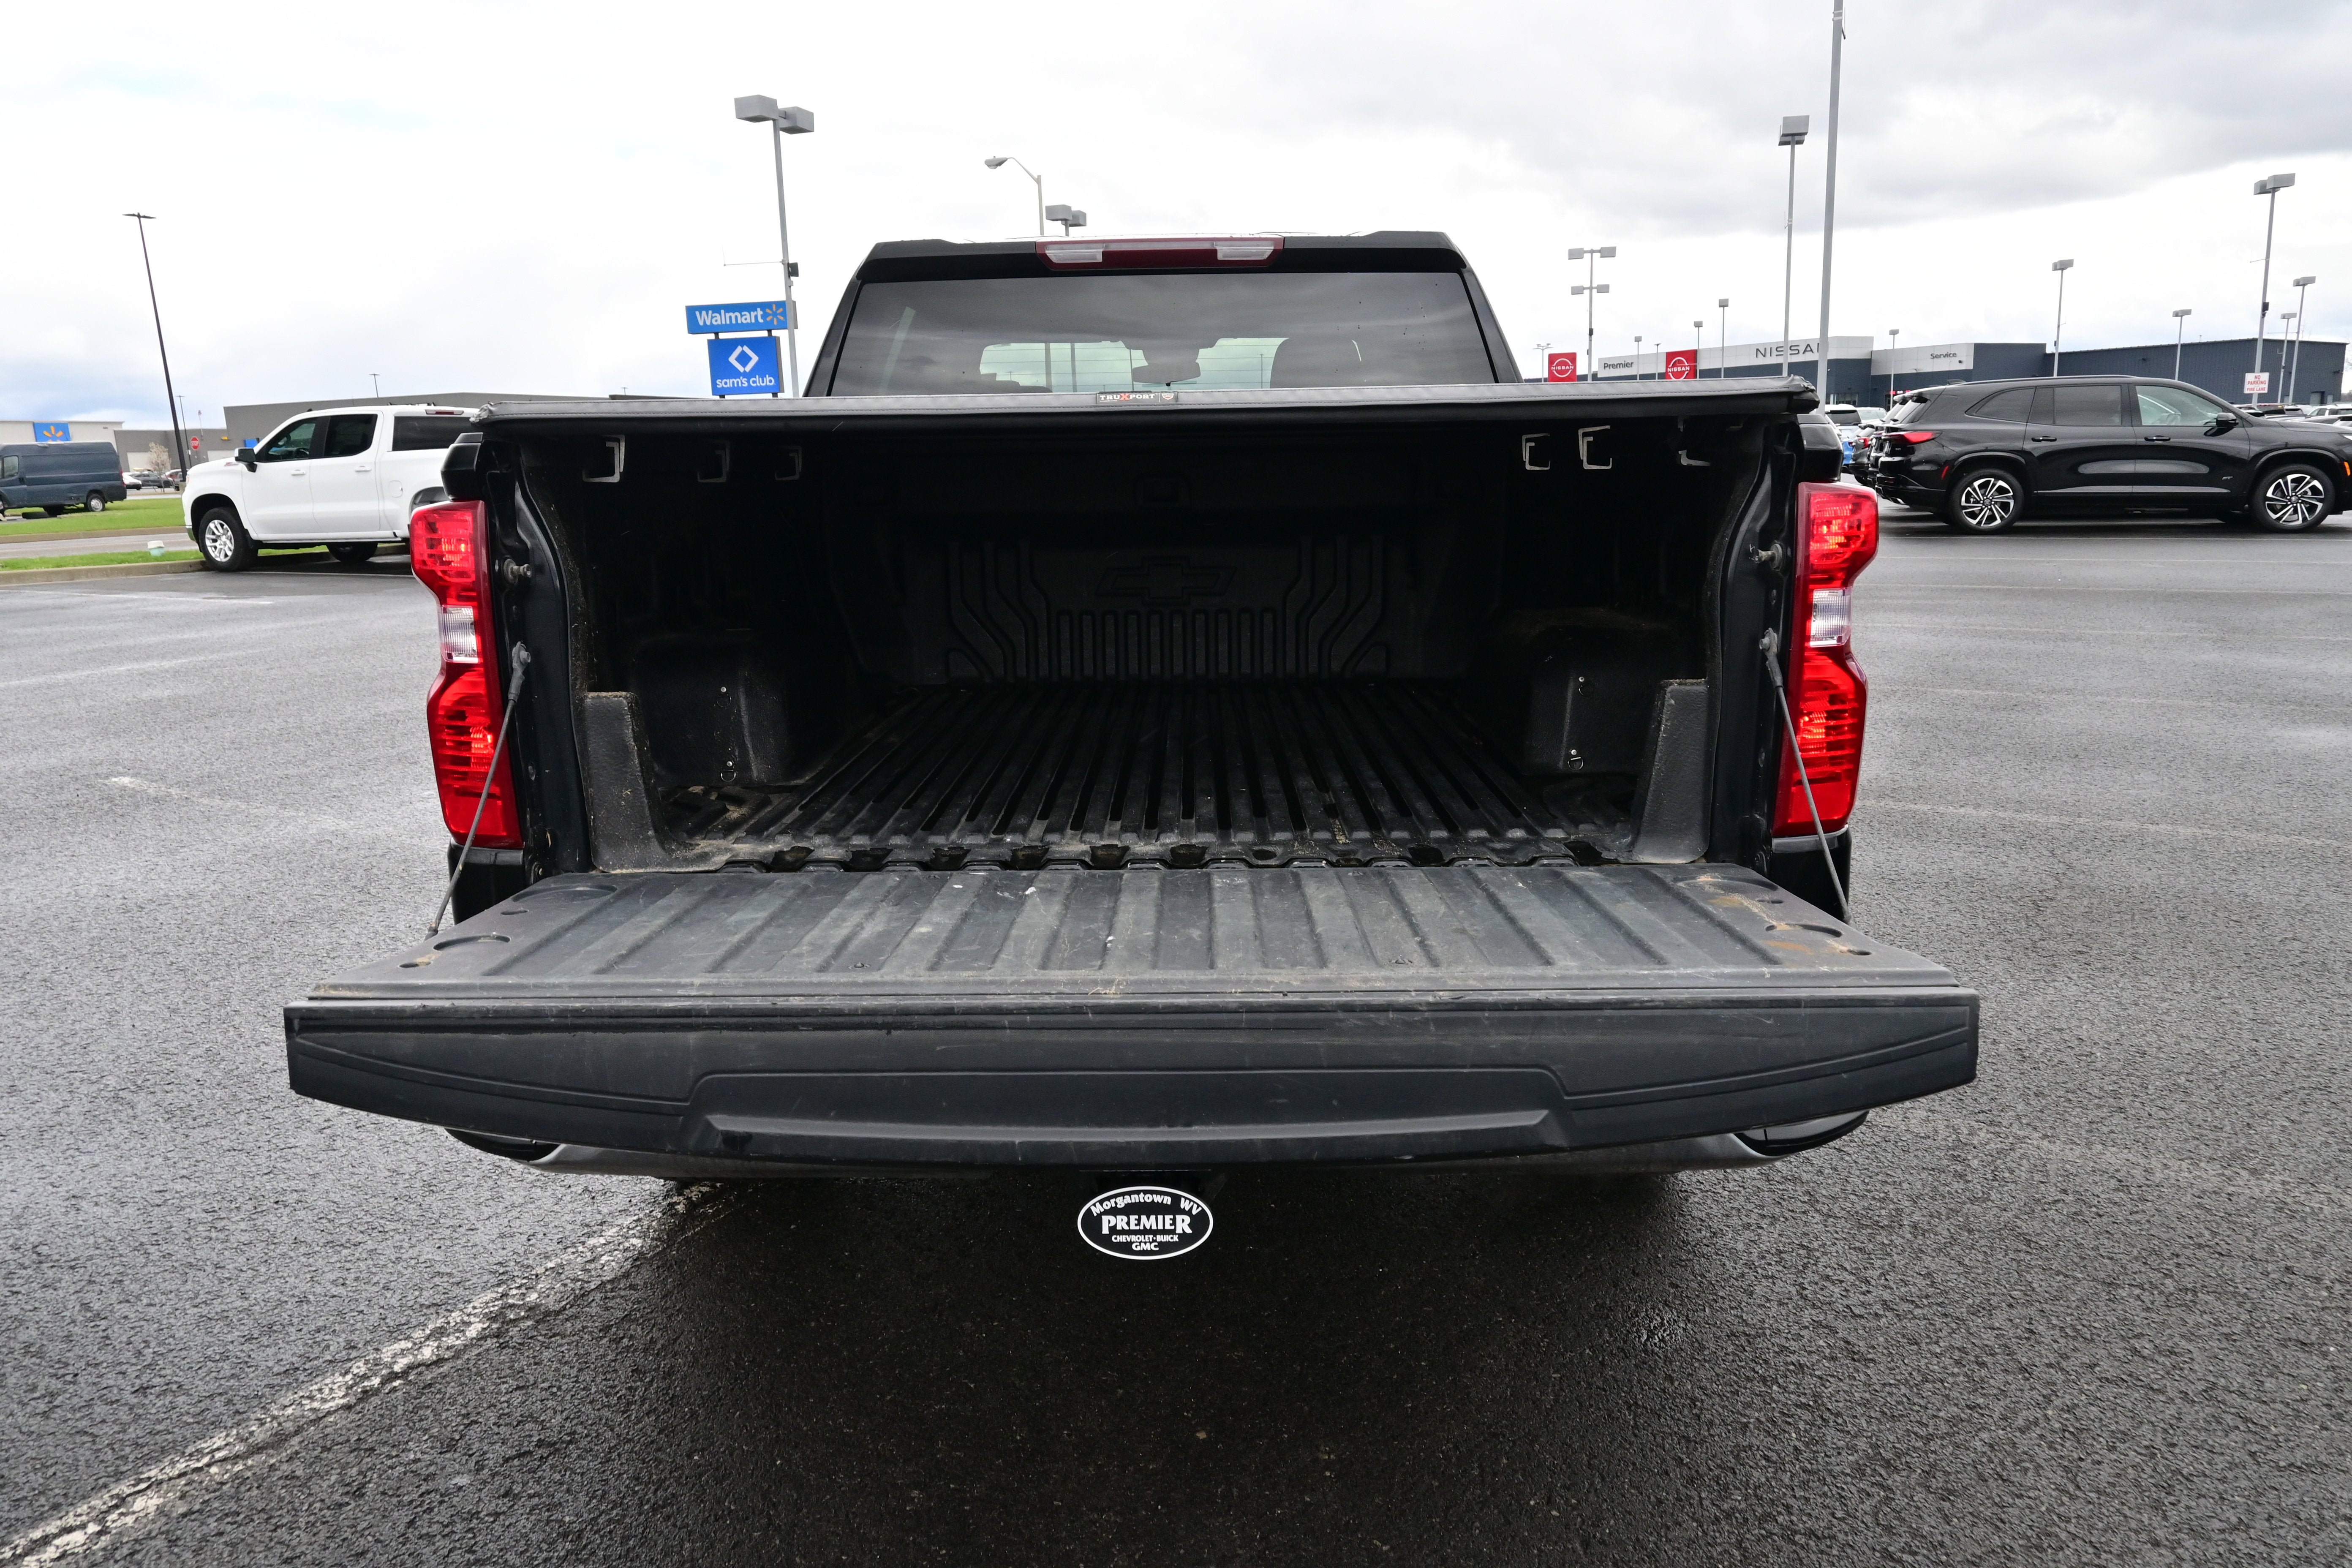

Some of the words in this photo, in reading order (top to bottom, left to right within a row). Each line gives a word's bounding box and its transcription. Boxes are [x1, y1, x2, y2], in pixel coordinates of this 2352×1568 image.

[695, 308, 763, 326] Walmart
[1756, 343, 1820, 358] NISSA
[1603, 361, 1634, 370] Premier
[716, 376, 748, 388] sam's
[750, 374, 774, 387] club
[1089, 1192, 1172, 1217] Morgantown
[1179, 1197, 1203, 1215] WV
[1101, 1214, 1192, 1235] PREMIER
[1132, 1242, 1159, 1251] GMC
